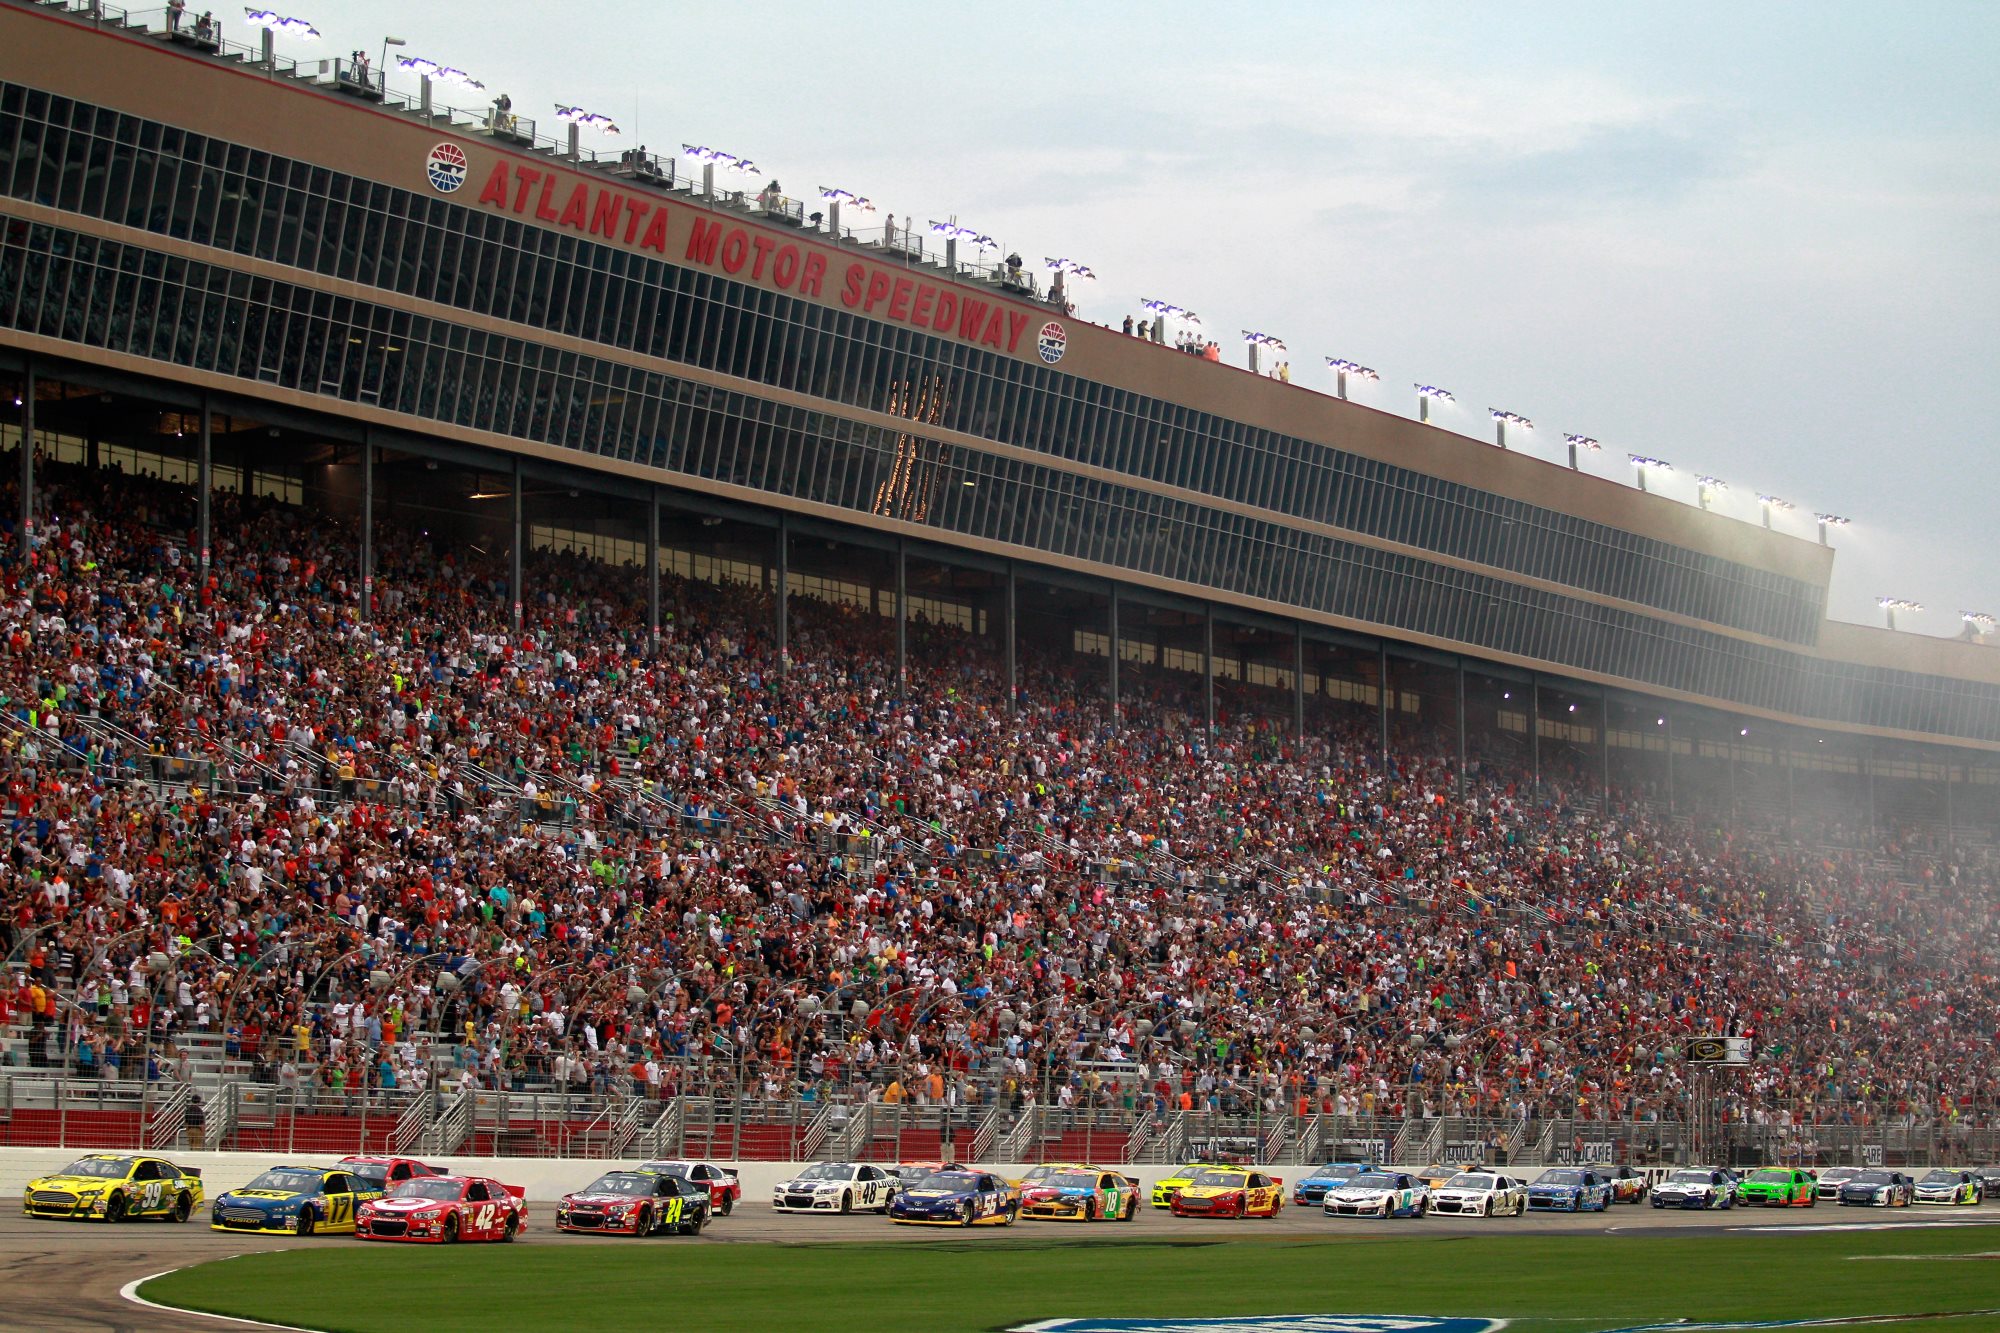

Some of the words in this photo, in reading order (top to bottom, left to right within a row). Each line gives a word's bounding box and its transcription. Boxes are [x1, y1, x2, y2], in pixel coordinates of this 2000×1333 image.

[479, 159, 668, 254] ATLANTA
[685, 217, 828, 298] MOTOR
[840, 263, 1030, 353] SPEEDWAY
[142, 1182, 162, 1208] 99
[862, 1181, 877, 1204] 48
[1105, 1191, 1118, 1212] 18
[332, 1196, 350, 1224] 17
[475, 1203, 496, 1230] 42
[665, 1197, 683, 1224] 24
